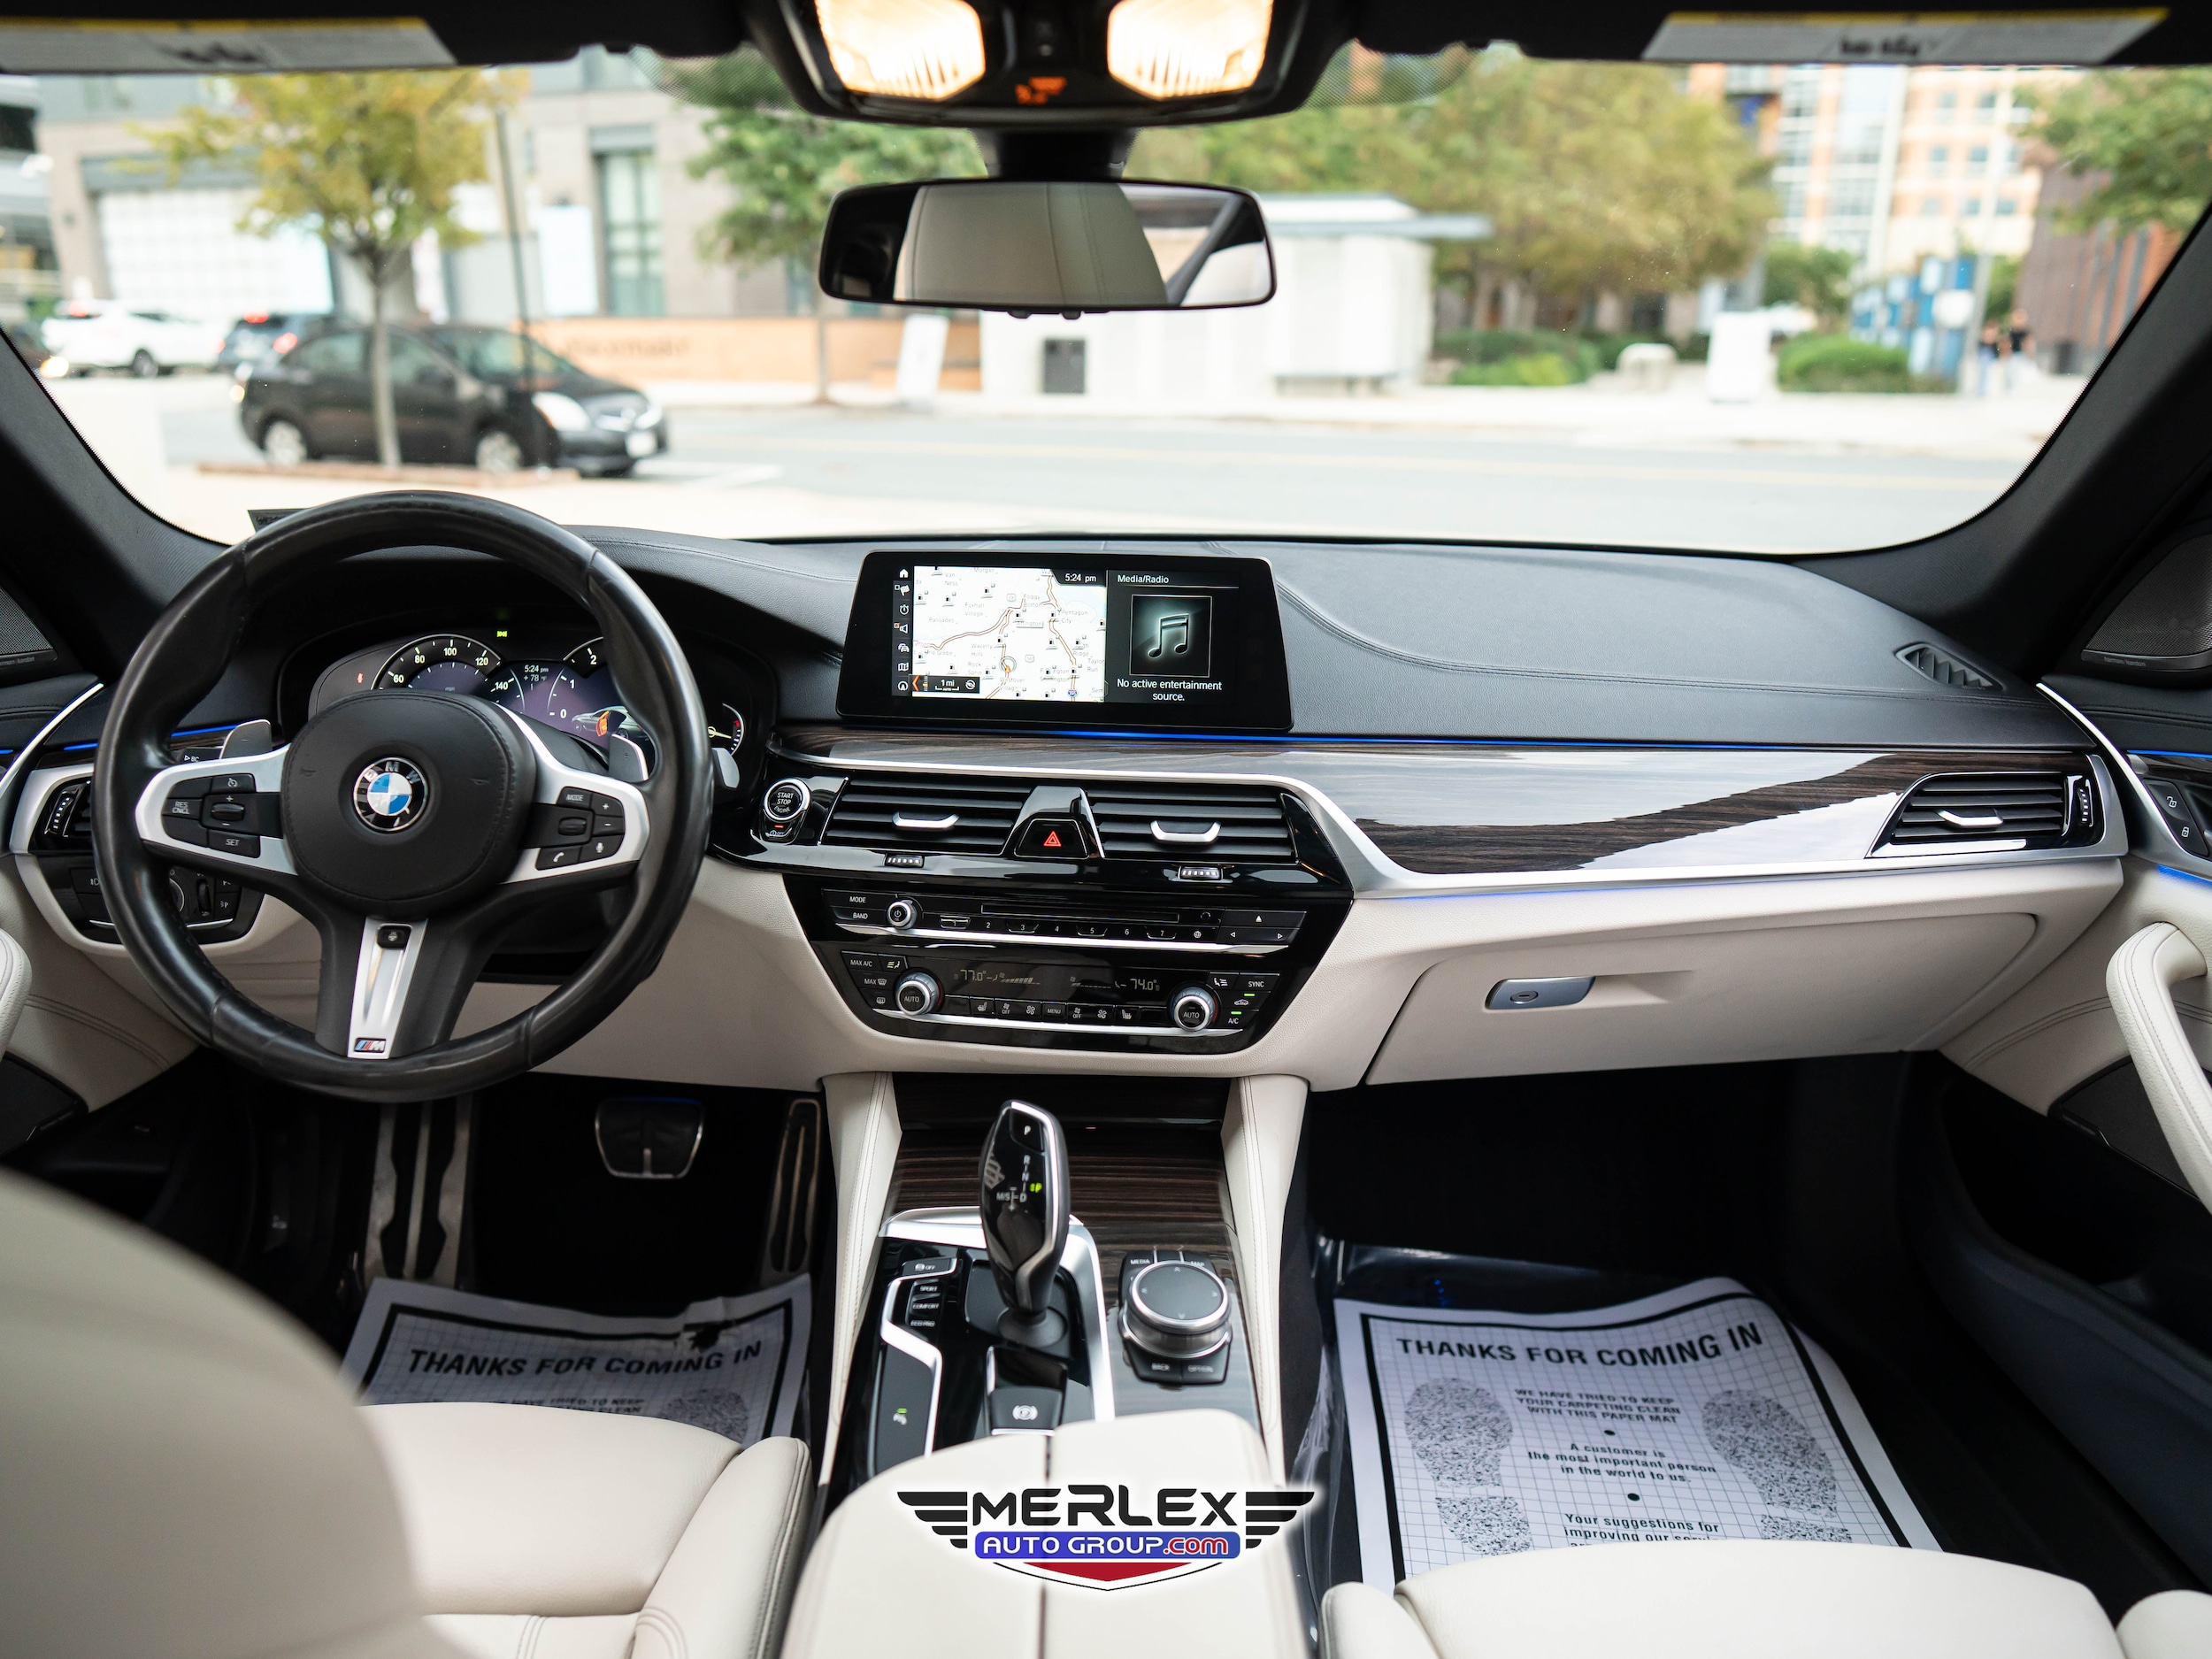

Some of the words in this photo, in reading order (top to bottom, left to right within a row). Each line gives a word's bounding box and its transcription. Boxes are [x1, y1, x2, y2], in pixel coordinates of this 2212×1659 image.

[1064, 573, 1081, 582] 5:24
[1117, 574, 1170, 585] Media/Radio
[443, 647, 457, 657] 100
[414, 655, 426, 664] 80
[475, 657, 489, 666] 120
[589, 655, 597, 664] 2
[393, 673, 404, 683] 60
[495, 681, 509, 690] 140
[569, 679, 575, 689] 1
[1117, 679, 1129, 687] No
[1131, 679, 1157, 689] active
[1159, 680, 1223, 690] entertainment
[1152, 692, 1186, 702] source.
[559, 709, 567, 718] 0
[364, 761, 421, 784] BMW
[226, 838, 241, 847] SET
[852, 911, 869, 920] BAND
[1024, 1125, 1032, 1136] P
[1396, 1337, 1517, 1362] THANKS
[1526, 1346, 1588, 1366] FOR
[1596, 1334, 1723, 1367] COMING
[1727, 1321, 1763, 1353] IN
[408, 1348, 526, 1377] THANKS
[534, 1356, 594, 1375] FOR
[604, 1351, 724, 1375] COMING
[733, 1340, 762, 1364] IN
[1539, 1391, 1573, 1400] HAVE
[1577, 1393, 1617, 1402] TRIED
[1641, 1396, 1675, 1405] KEEP
[1517, 1396, 1554, 1407] YOUR
[1557, 1400, 1633, 1413] CARPETING
[1638, 1405, 1681, 1415] CLEAN
[1527, 1405, 1563, 1415] WITH
[1566, 1409, 1598, 1419] THIS
[1601, 1411, 1646, 1423] PAPER
[1649, 1414, 1678, 1424] MAT
[1584, 1445, 1648, 1456] customer
[1653, 1449, 1666, 1458] is
[1528, 1451, 1550, 1461] the
[1555, 1453, 1590, 1463] most
[1594, 1455, 1663, 1469] important
[1668, 1462, 1717, 1474] person
[1561, 1464, 1574, 1474] in
[1579, 1466, 1601, 1476] the
[1606, 1468, 1646, 1479] world
[1650, 1470, 1664, 1481] to
[1669, 1474, 1692, 1483] us.
[1564, 1513, 1598, 1525] Your
[1603, 1517, 1694, 1531] suggestions
[1698, 1521, 1719, 1533] for
[1563, 1526, 1640, 1542] improving
[1645, 1532, 1670, 1541] our
